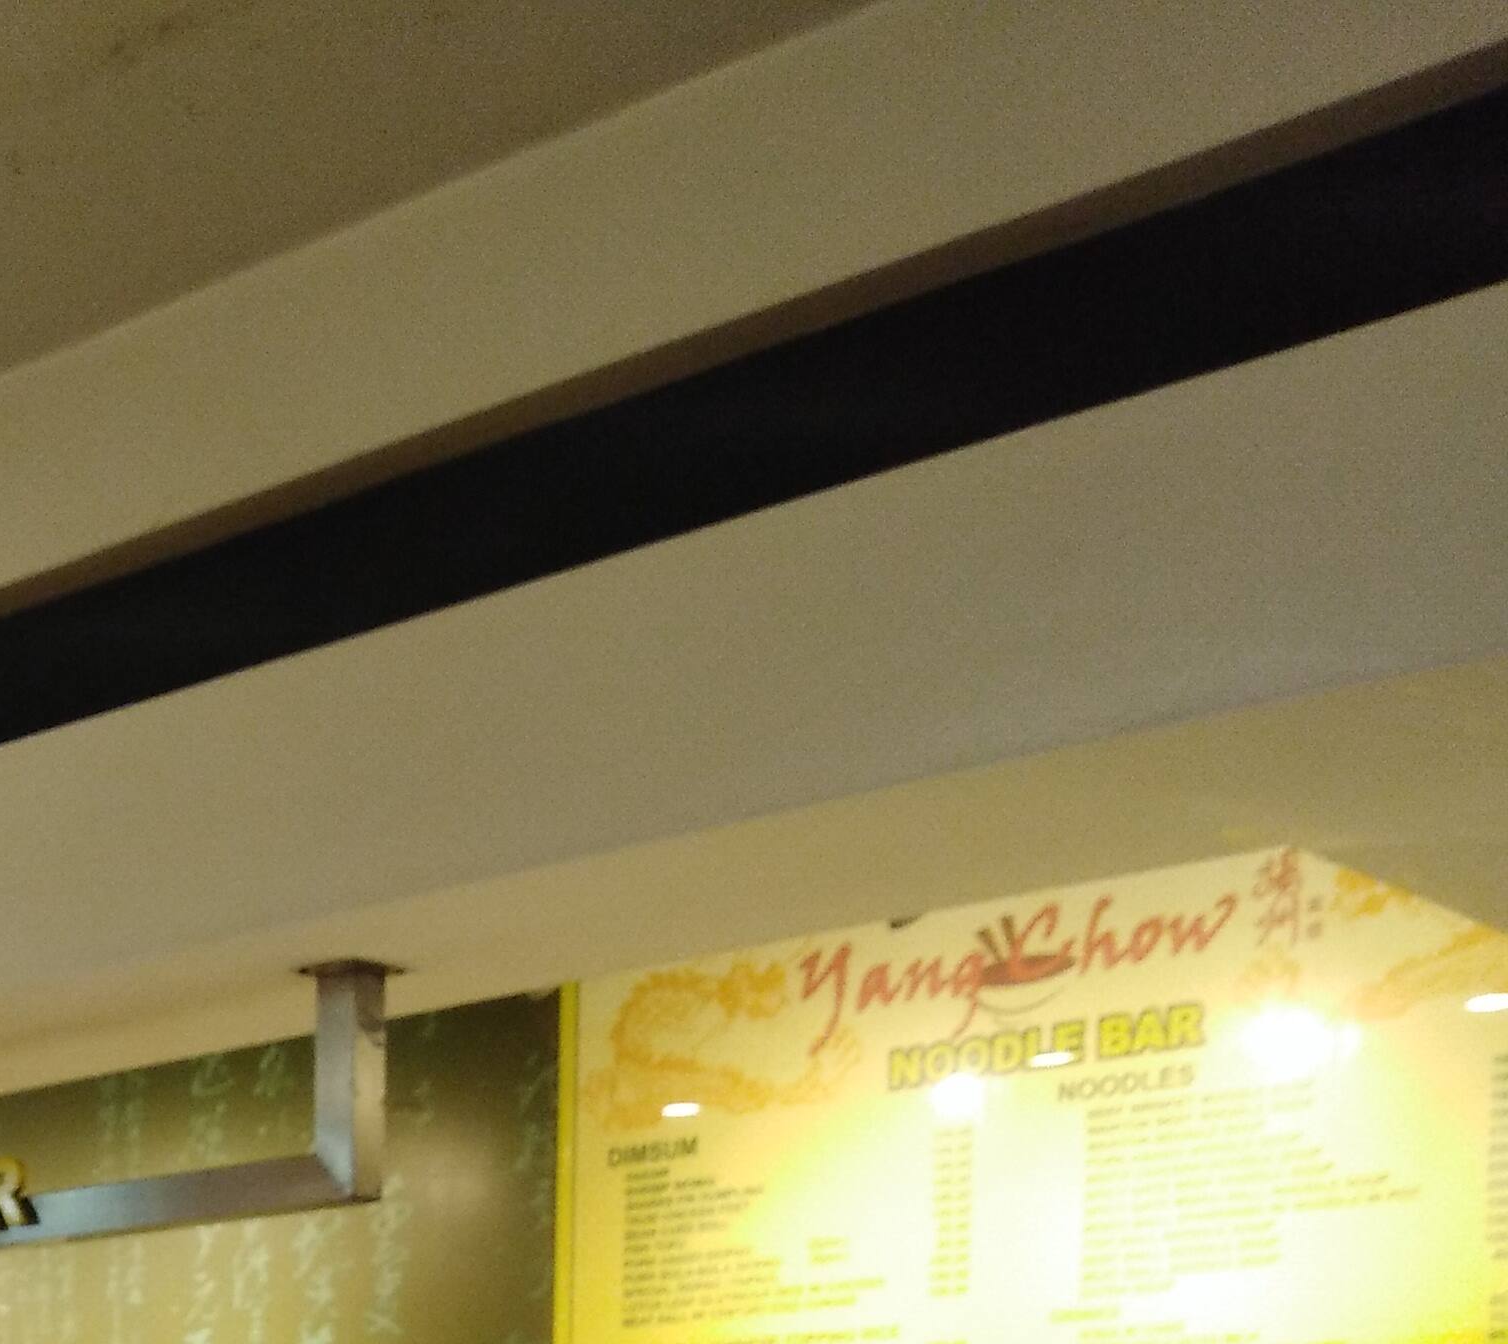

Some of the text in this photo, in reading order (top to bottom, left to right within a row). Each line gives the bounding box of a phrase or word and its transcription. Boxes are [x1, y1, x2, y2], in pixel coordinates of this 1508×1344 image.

[889, 1003, 1205, 1091] NOODLE BAR
[1057, 1064, 1195, 1101] NOODLES
[607, 1137, 698, 1167] DIMSUM
